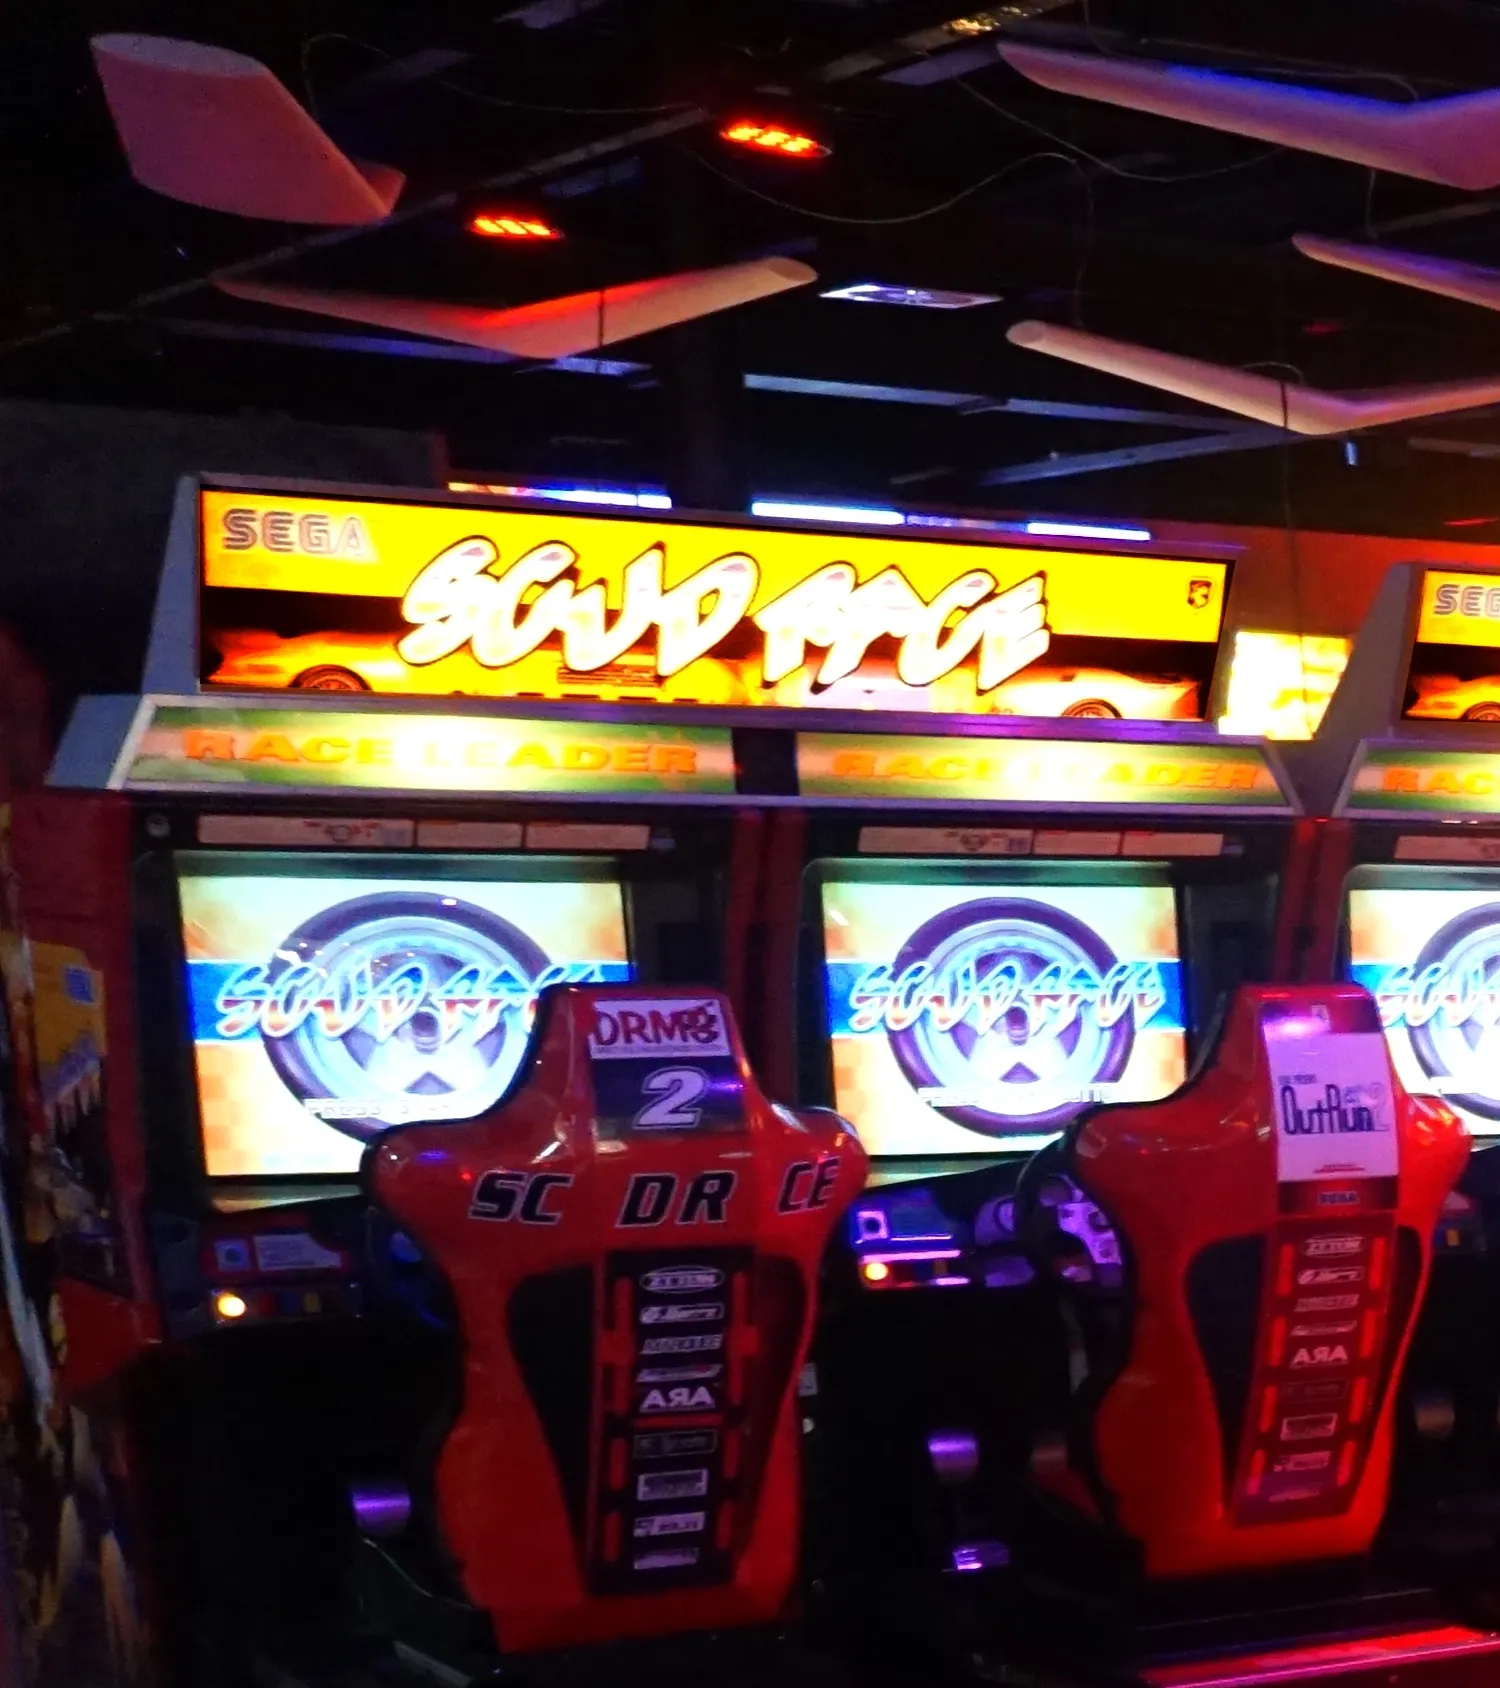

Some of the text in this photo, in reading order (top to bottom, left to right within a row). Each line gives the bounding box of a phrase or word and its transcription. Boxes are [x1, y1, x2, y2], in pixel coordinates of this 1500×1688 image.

[222, 507, 376, 557] SEGA
[395, 535, 1051, 695] SCUD RACE
[185, 729, 393, 765] RACE
[831, 749, 988, 783] RACE
[216, 961, 430, 1041] SCUD
[848, 962, 1021, 1034] SCUD
[634, 1066, 709, 1132] 2
